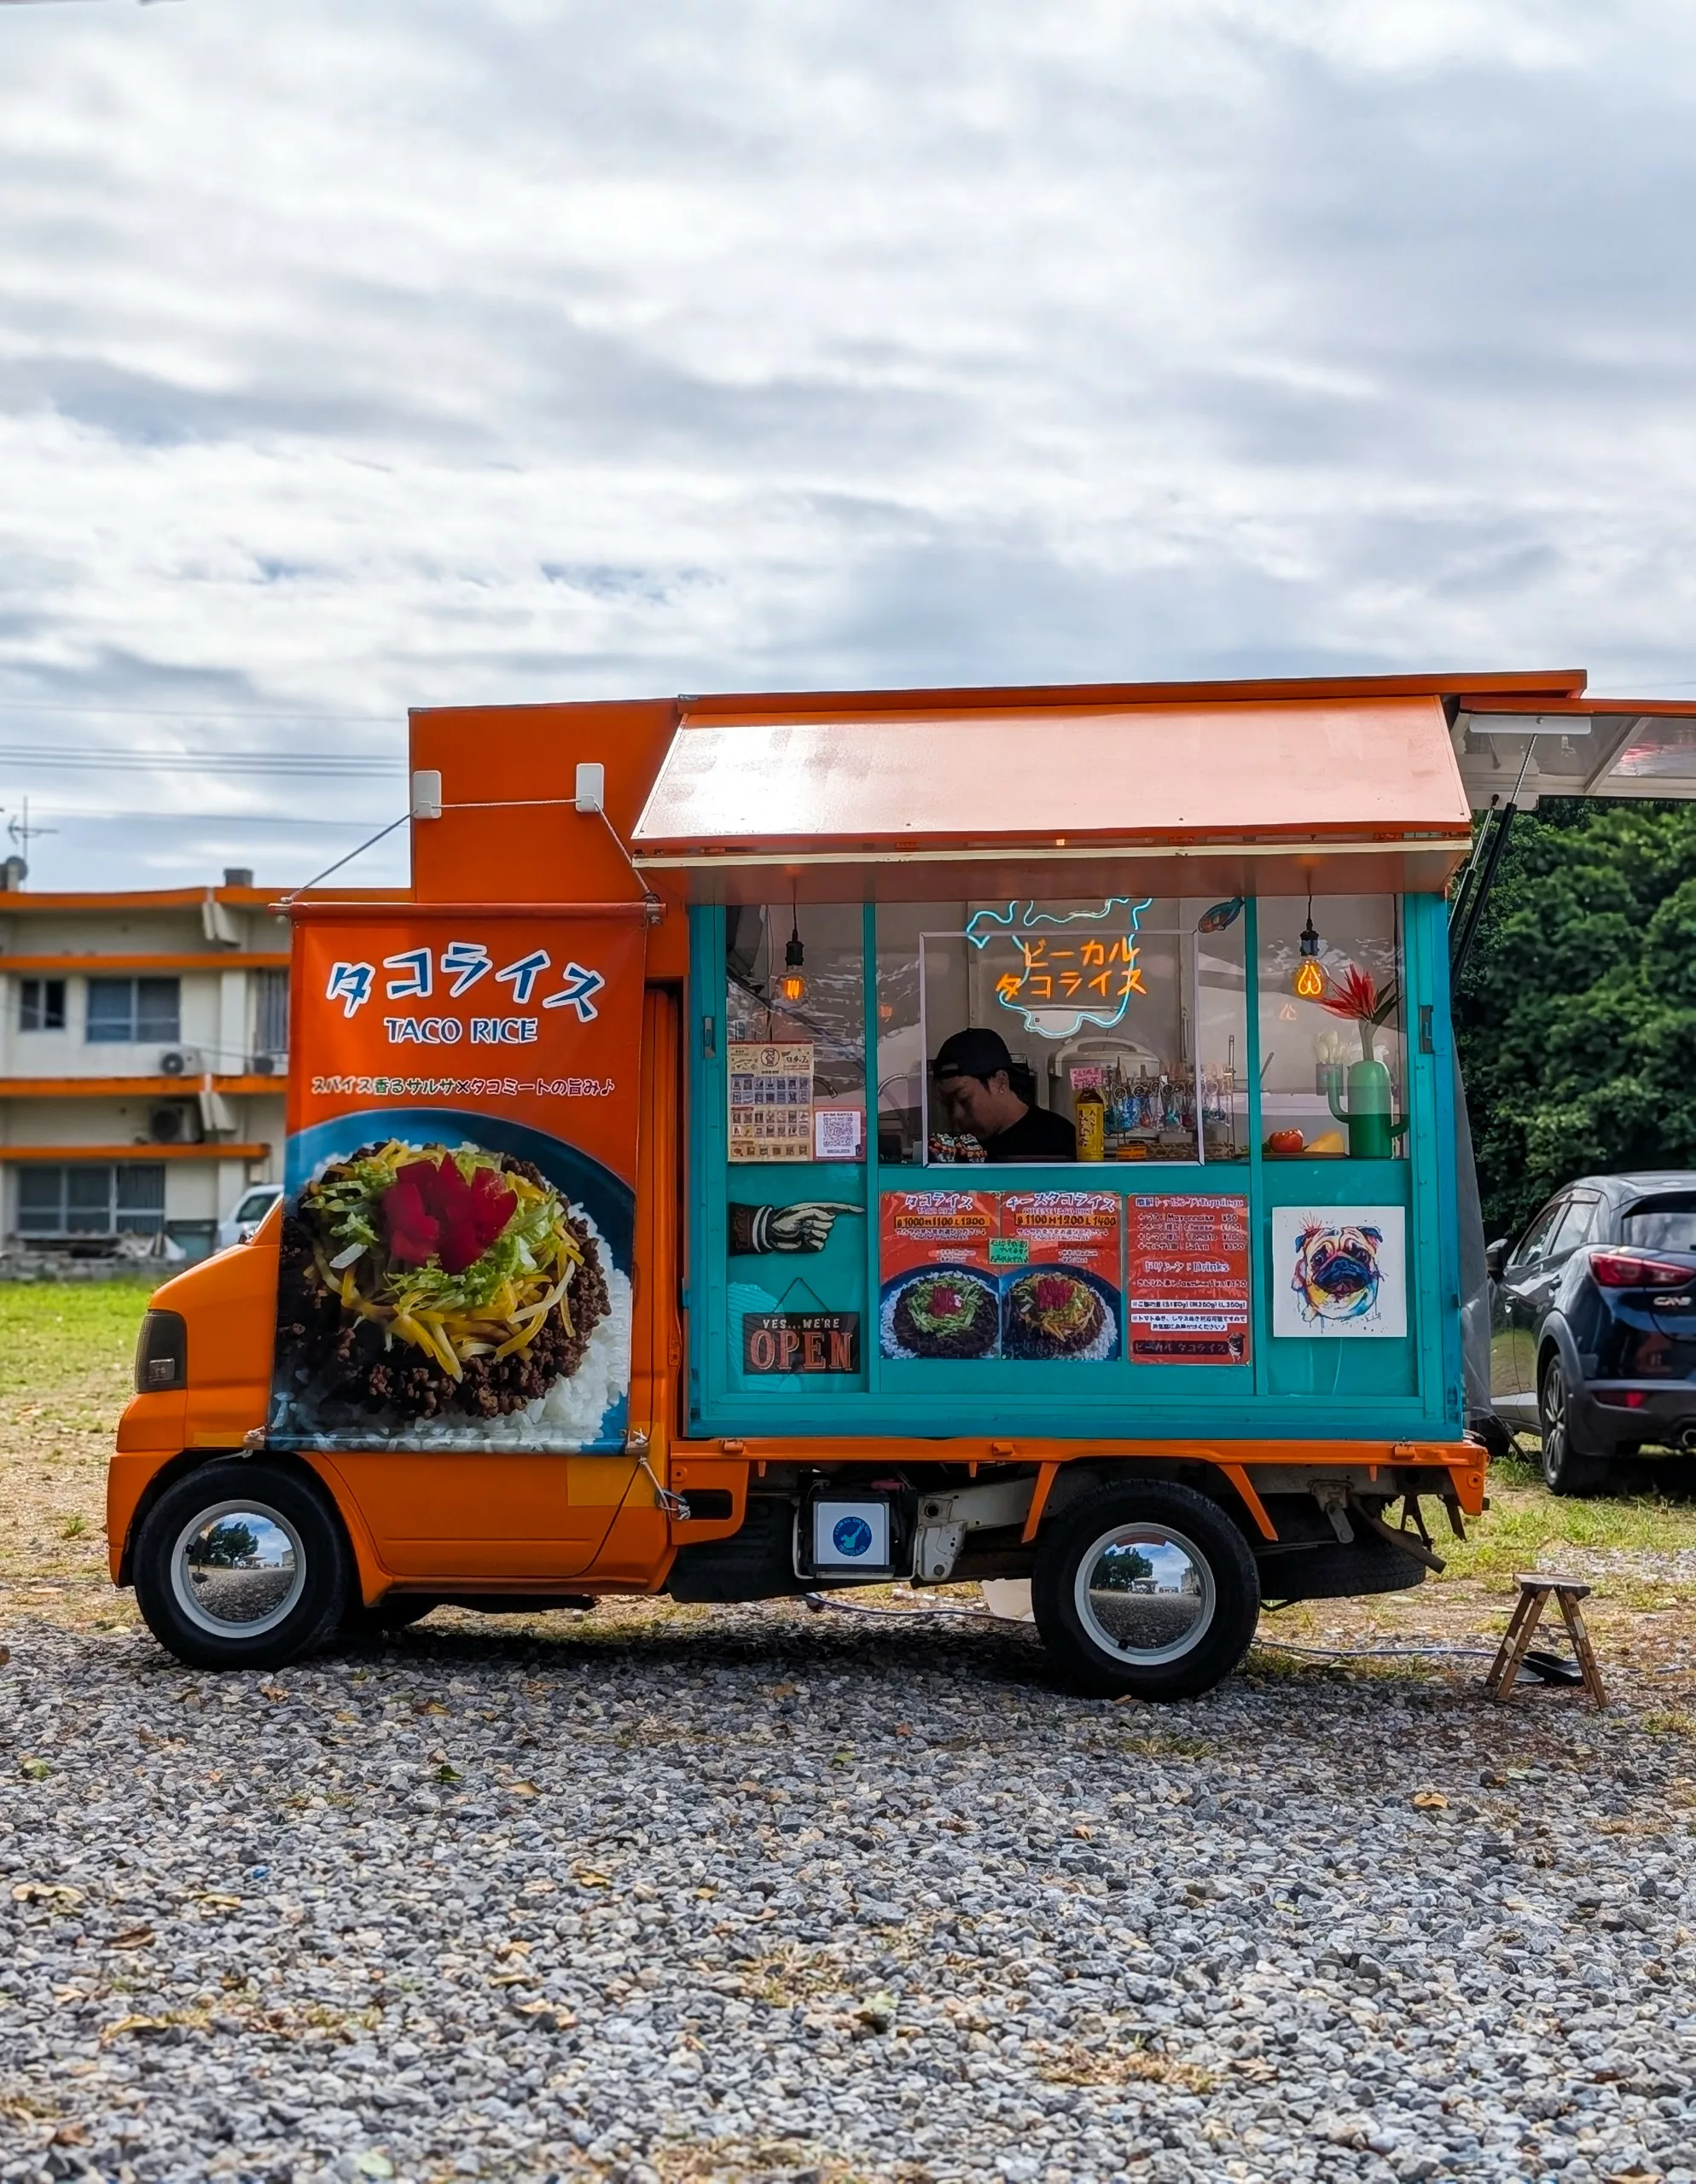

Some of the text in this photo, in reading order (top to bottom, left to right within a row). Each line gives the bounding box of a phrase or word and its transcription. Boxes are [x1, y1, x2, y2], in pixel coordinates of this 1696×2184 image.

[1023, 938, 1141, 967] ビーカル
[326, 942, 605, 1022] タコライス
[996, 969, 1147, 1000] タコライス
[384, 1018, 538, 1043] TACO RICE
[905, 1192, 973, 1211] タコライス
[904, 1217, 924, 1226] 1000
[932, 1217, 954, 1226] 1100
[1025, 1215, 1048, 1225] 1100
[1058, 1215, 1084, 1225] 1200
[1085, 1217, 1091, 1225] L
[1093, 1216, 1117, 1226] 1400
[1193, 1262, 1229, 1272] Drinks
[803, 1318, 839, 1328] WE'RE
[750, 1329, 853, 1370] OPEN
